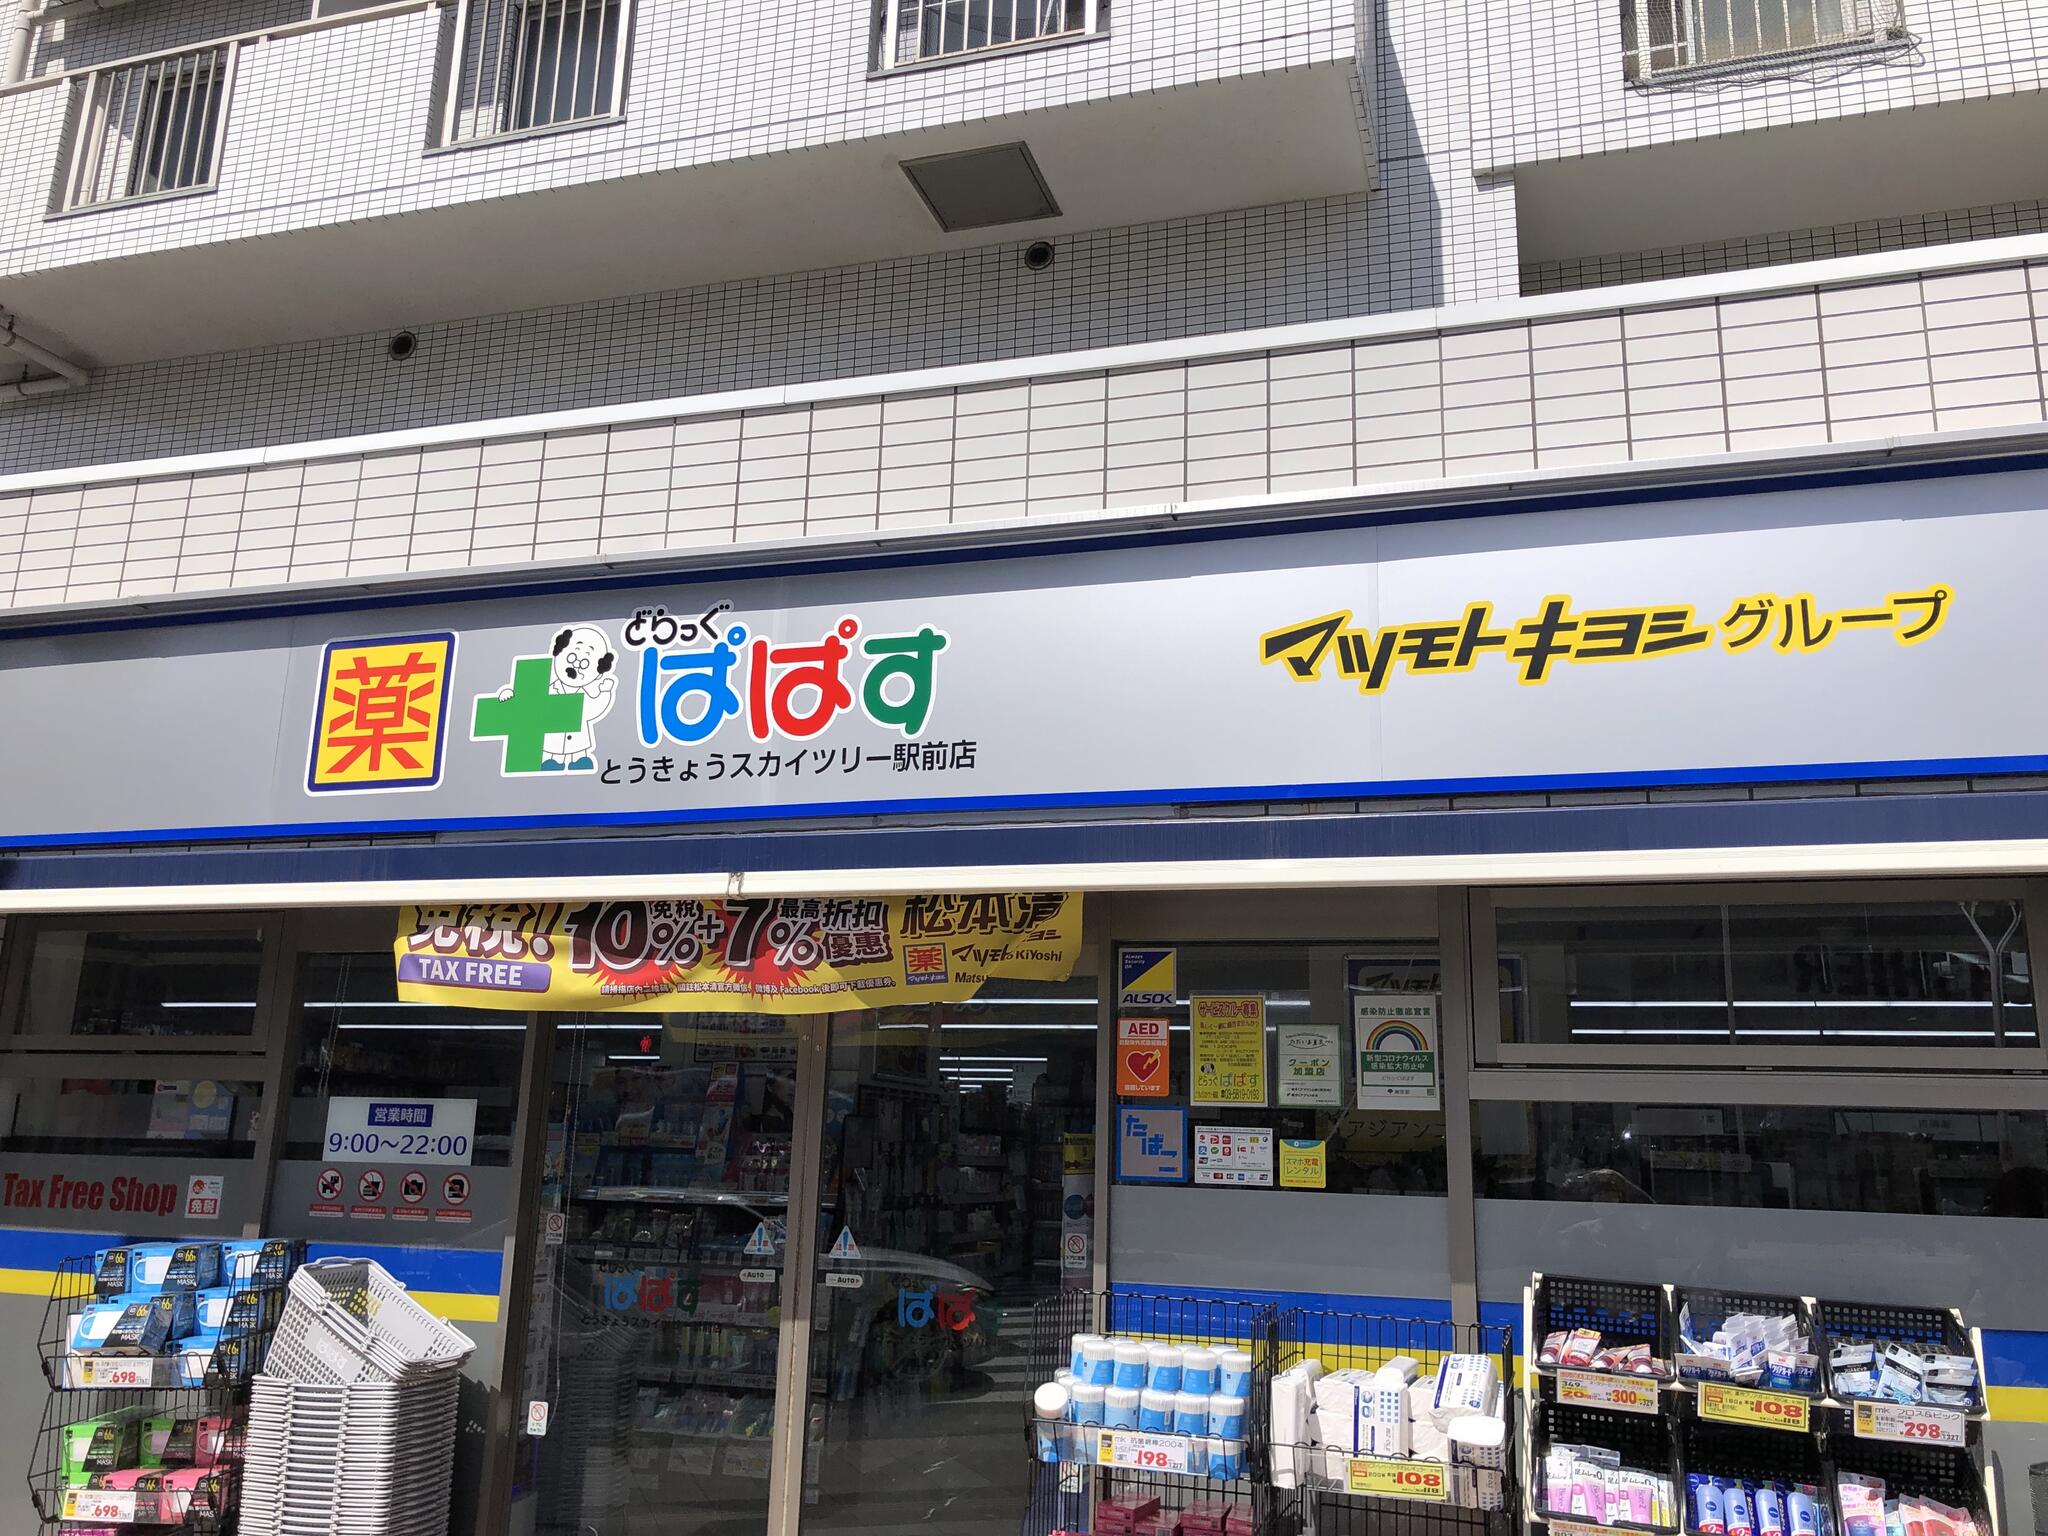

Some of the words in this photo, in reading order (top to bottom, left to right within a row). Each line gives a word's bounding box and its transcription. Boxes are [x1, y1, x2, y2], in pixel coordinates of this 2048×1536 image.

[625, 603, 730, 646] どらっぐ
[640, 618, 947, 745] ぱぱす
[325, 651, 430, 776] 薬
[600, 739, 977, 785] とうきょうスカイツリー駅前店
[908, 945, 944, 973] 薬
[419, 958, 459, 981] TAX
[465, 961, 523, 986] FREE
[1122, 993, 1173, 1004] ALSOK
[1128, 1022, 1159, 1035] AED
[374, 1107, 427, 1123] 営業時間
[4, 1173, 45, 1208] Tax
[48, 1174, 105, 1210] Free
[109, 1175, 178, 1216] Shop
[121, 1333, 140, 1341] MASK
[1612, 1389, 1637, 1404] 300
[1754, 1400, 1802, 1418] 108
[1904, 1422, 1940, 1439] 298
[1137, 1450, 1168, 1467] 198
[1396, 1471, 1441, 1487] 108
